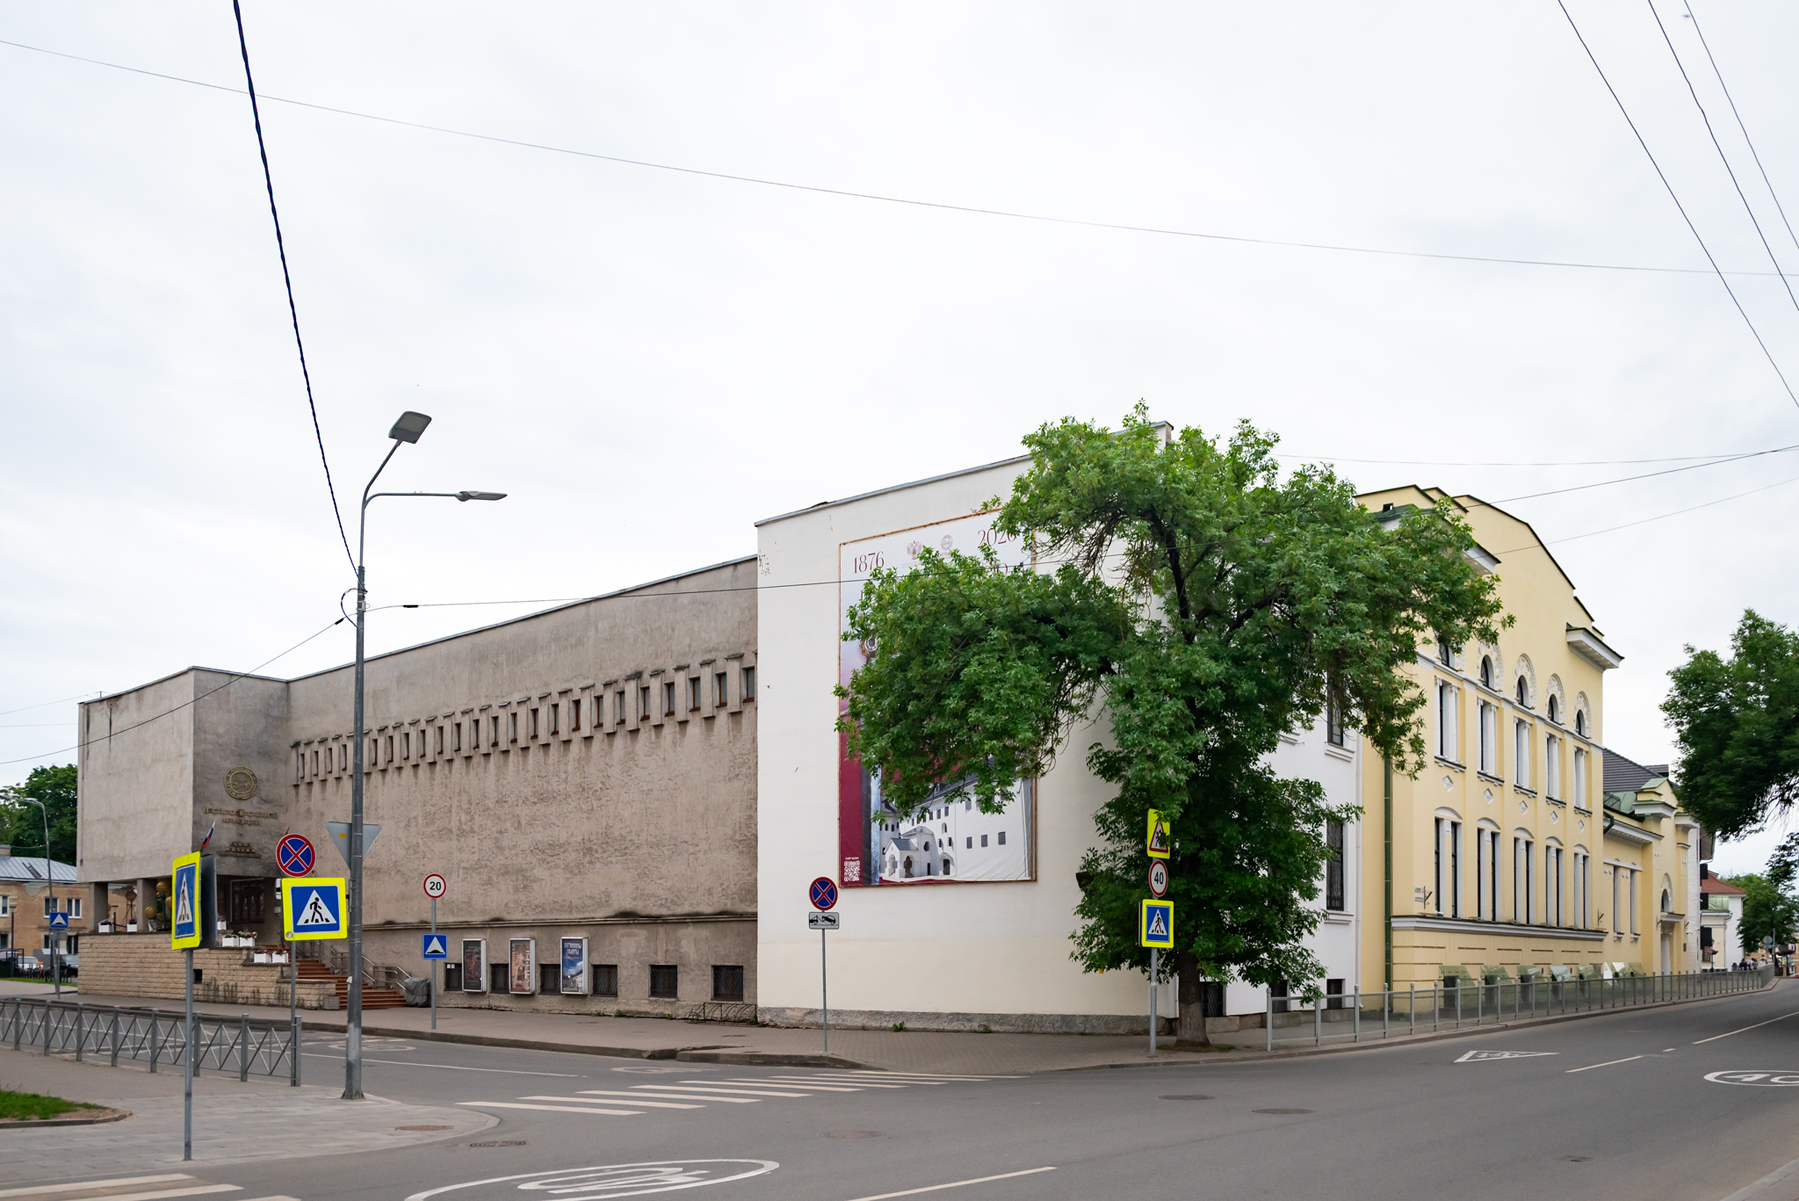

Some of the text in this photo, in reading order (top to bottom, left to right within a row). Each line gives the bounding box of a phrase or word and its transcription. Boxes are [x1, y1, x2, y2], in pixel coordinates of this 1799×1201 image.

[853, 551, 885, 574] 1876
[1153, 871, 1164, 885] 40
[429, 881, 442, 891] 20
